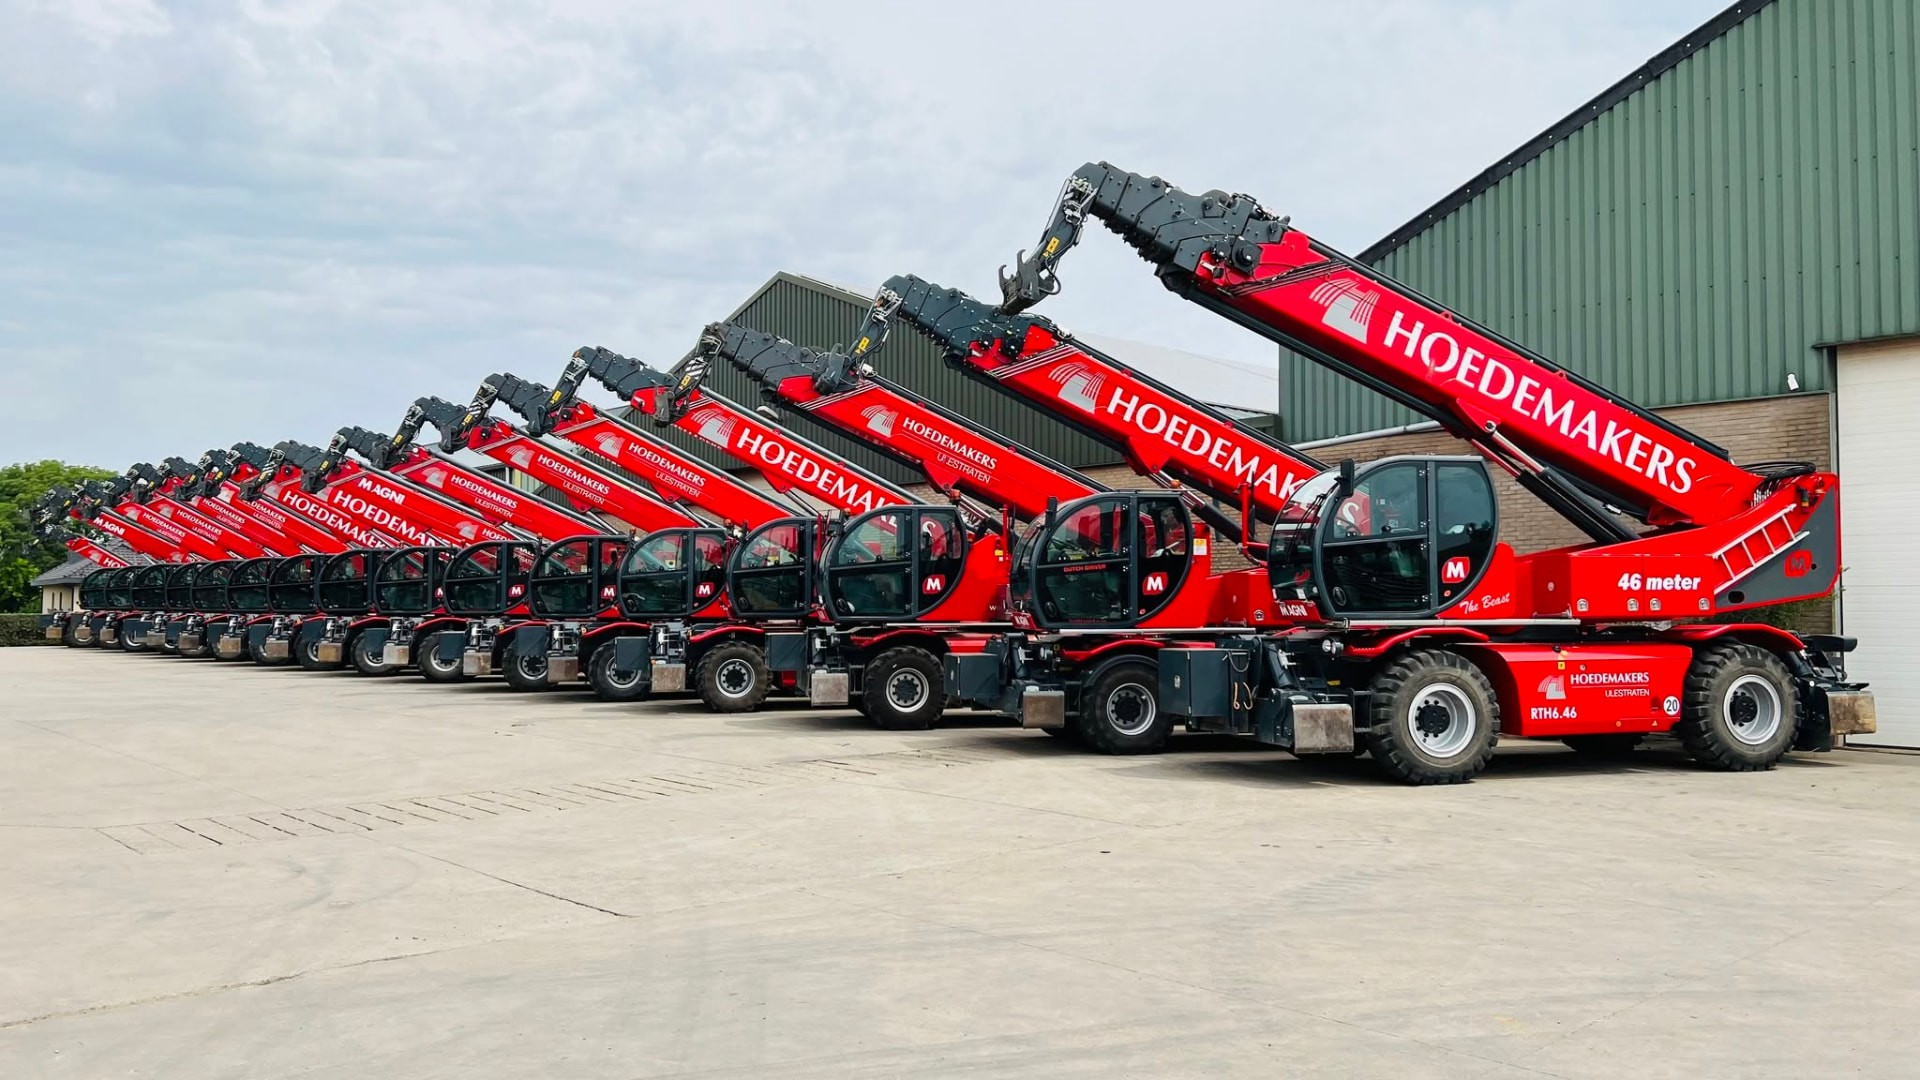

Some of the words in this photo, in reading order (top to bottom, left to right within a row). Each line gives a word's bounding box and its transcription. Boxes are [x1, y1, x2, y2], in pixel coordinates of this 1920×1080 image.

[1383, 310, 1697, 494] HOEDEMAKERS
[902, 417, 997, 469] HOEDEMAKERS
[537, 454, 610, 495] HOEDEMAKERS
[628, 442, 706, 487] HOEDEMAKERS
[358, 477, 406, 505] MAGNI
[451, 474, 518, 509] HOEDEMAKERS
[562, 480, 605, 505] ULESTRATEN
[655, 470, 700, 498] ULESTRATEN
[203, 498, 246, 525] HOEDEMAKERS
[474, 497, 513, 518] ULESTRATEN
[93, 517, 126, 536] MAGNI
[142, 512, 186, 538] HOEDEMAKERS
[176, 509, 222, 536] HOEDEMAKERS
[1446, 562, 1464, 578] M
[511, 586, 522, 595] M
[603, 587, 615, 597] M
[698, 584, 711, 595] M
[926, 578, 941, 591] M
[1146, 576, 1164, 591] M
[1618, 573, 1642, 591] 46
[1645, 573, 1701, 591] meter
[1279, 604, 1309, 616] MAGNI
[1459, 601, 1480, 615] The
[1482, 592, 1511, 609] Beast
[1570, 672, 1649, 684] HOEDEMAKERS
[1605, 689, 1650, 698] ULESTRATEN
[1531, 707, 1577, 720] RTH6.46
[1666, 699, 1678, 713] 20
